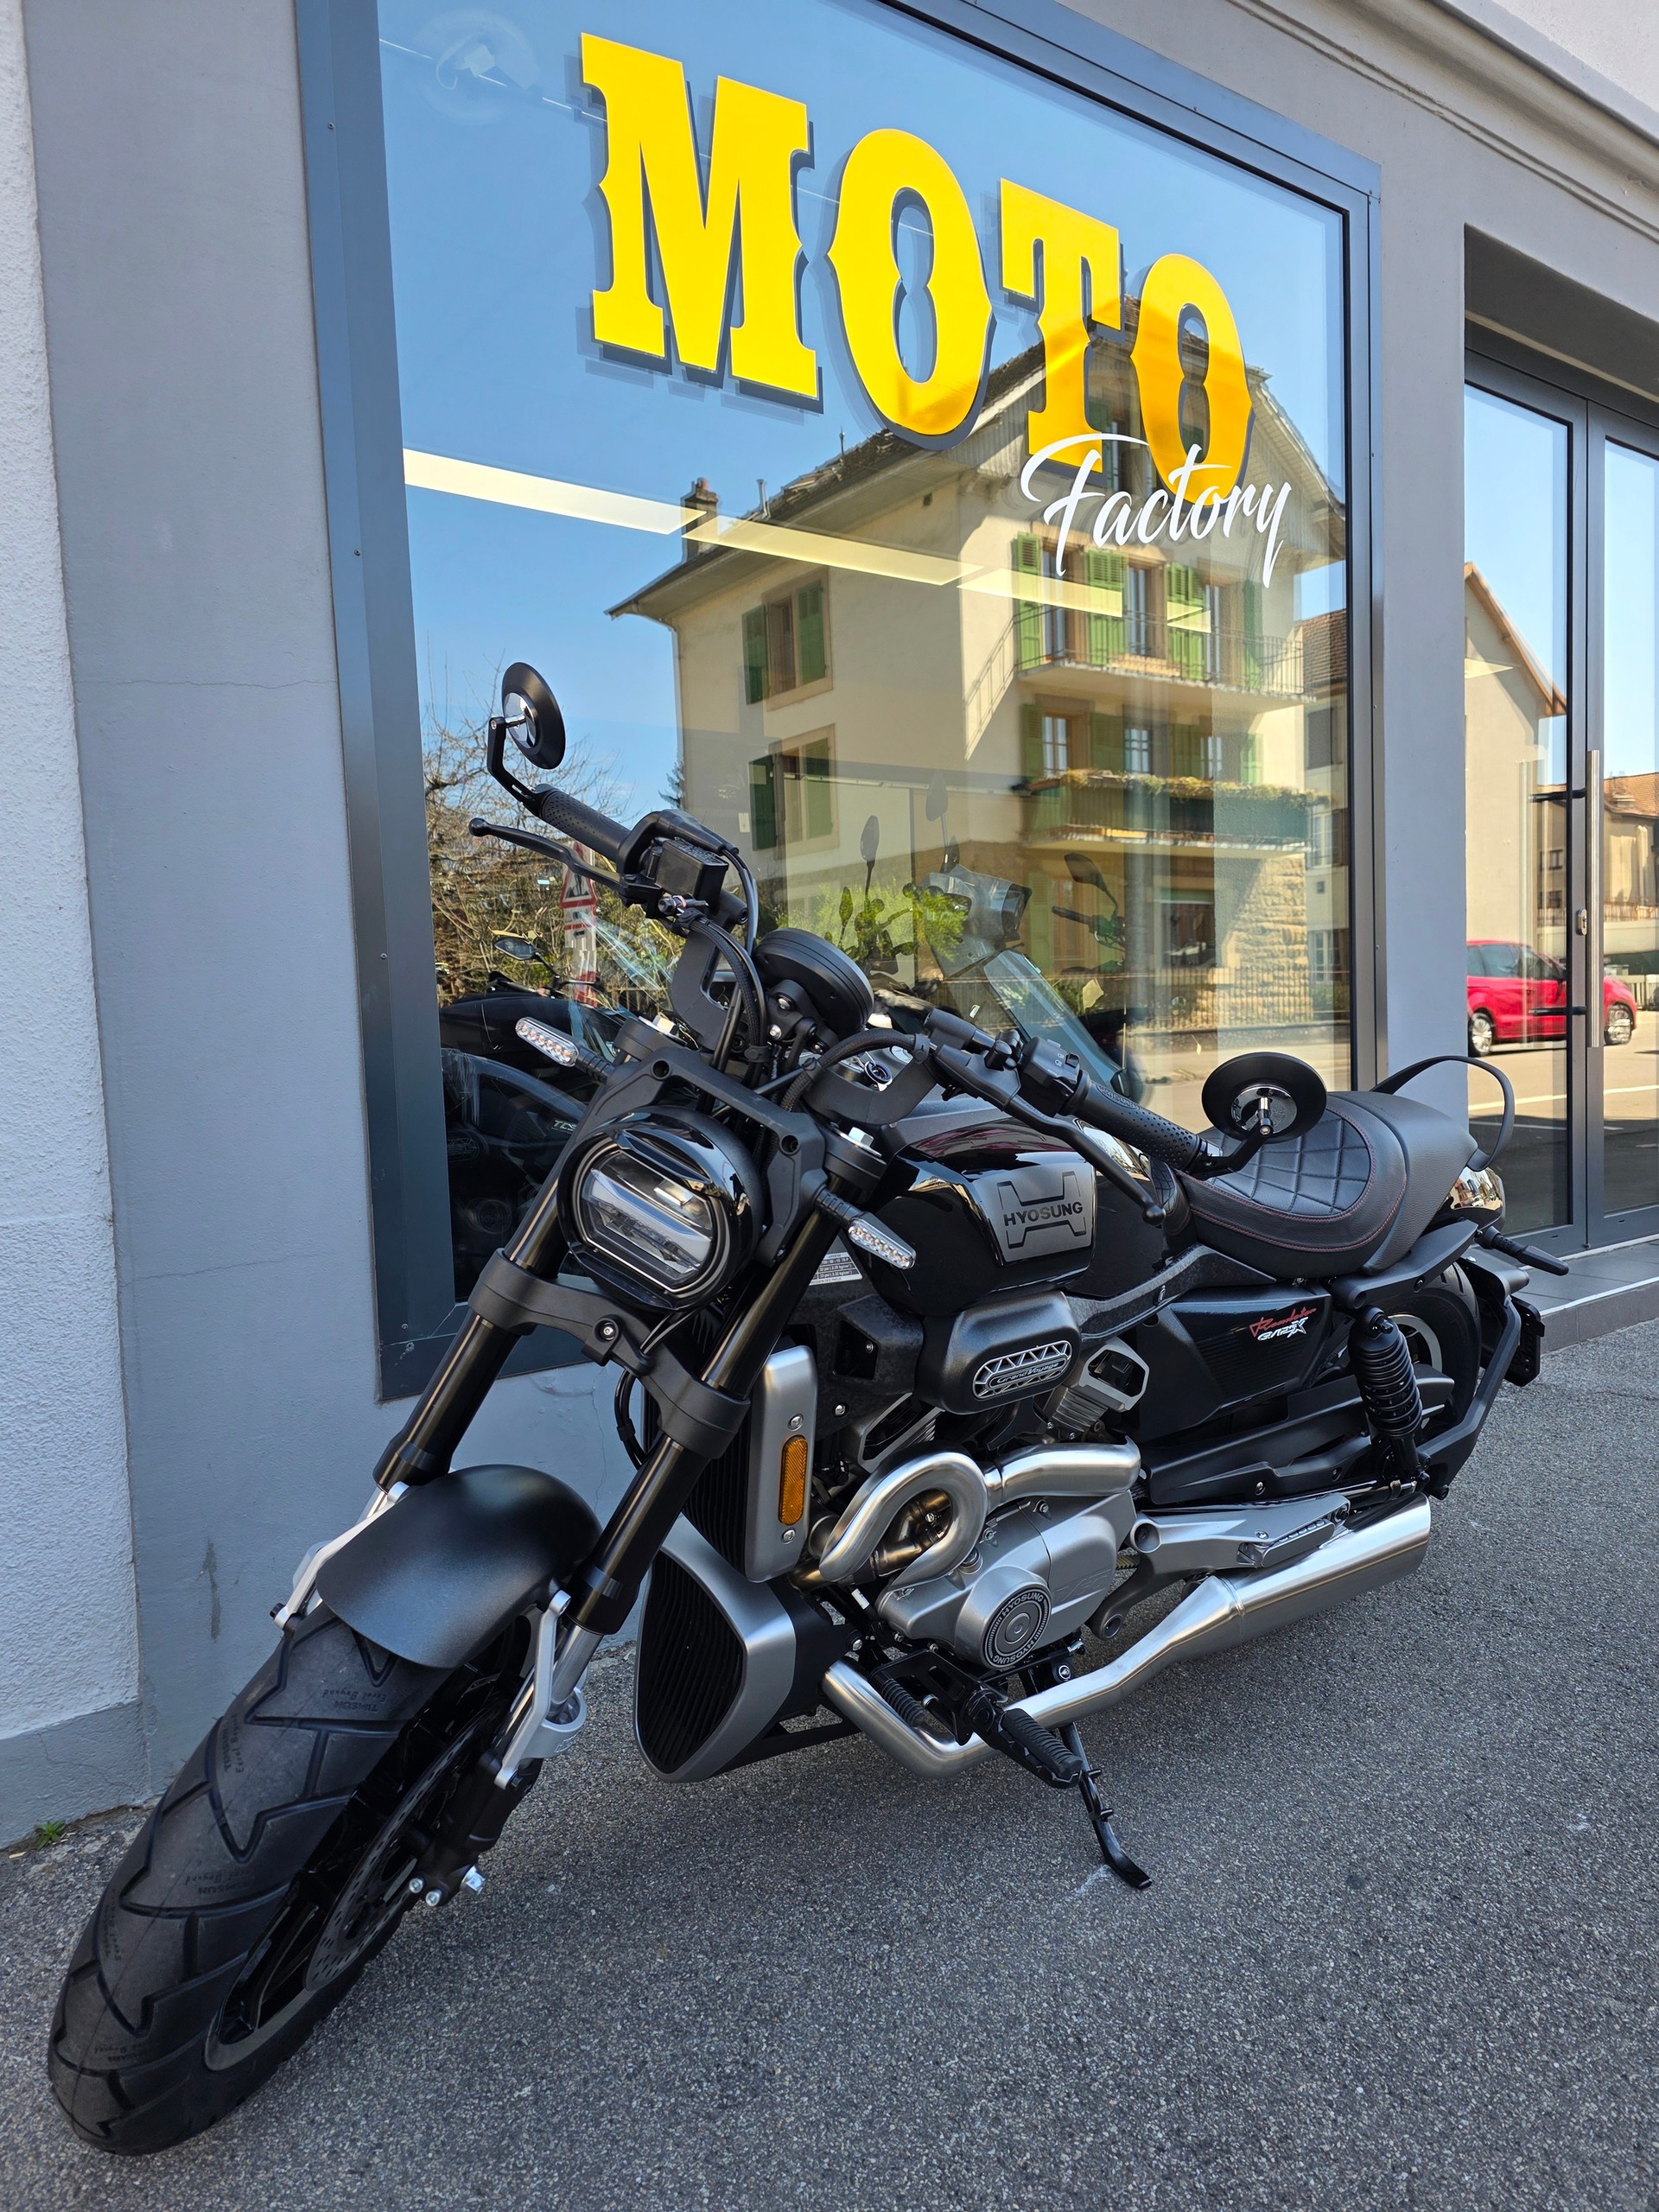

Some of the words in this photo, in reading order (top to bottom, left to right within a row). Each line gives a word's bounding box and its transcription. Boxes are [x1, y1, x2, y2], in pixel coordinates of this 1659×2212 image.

[582, 32, 1255, 505] MOTO
[1020, 432, 1294, 588] Factory
[1003, 1201, 1084, 1226] HYOSUNG
[1001, 1592, 1044, 1617] HYOSUNG
[993, 1640, 1034, 1664] HYOSUNG
